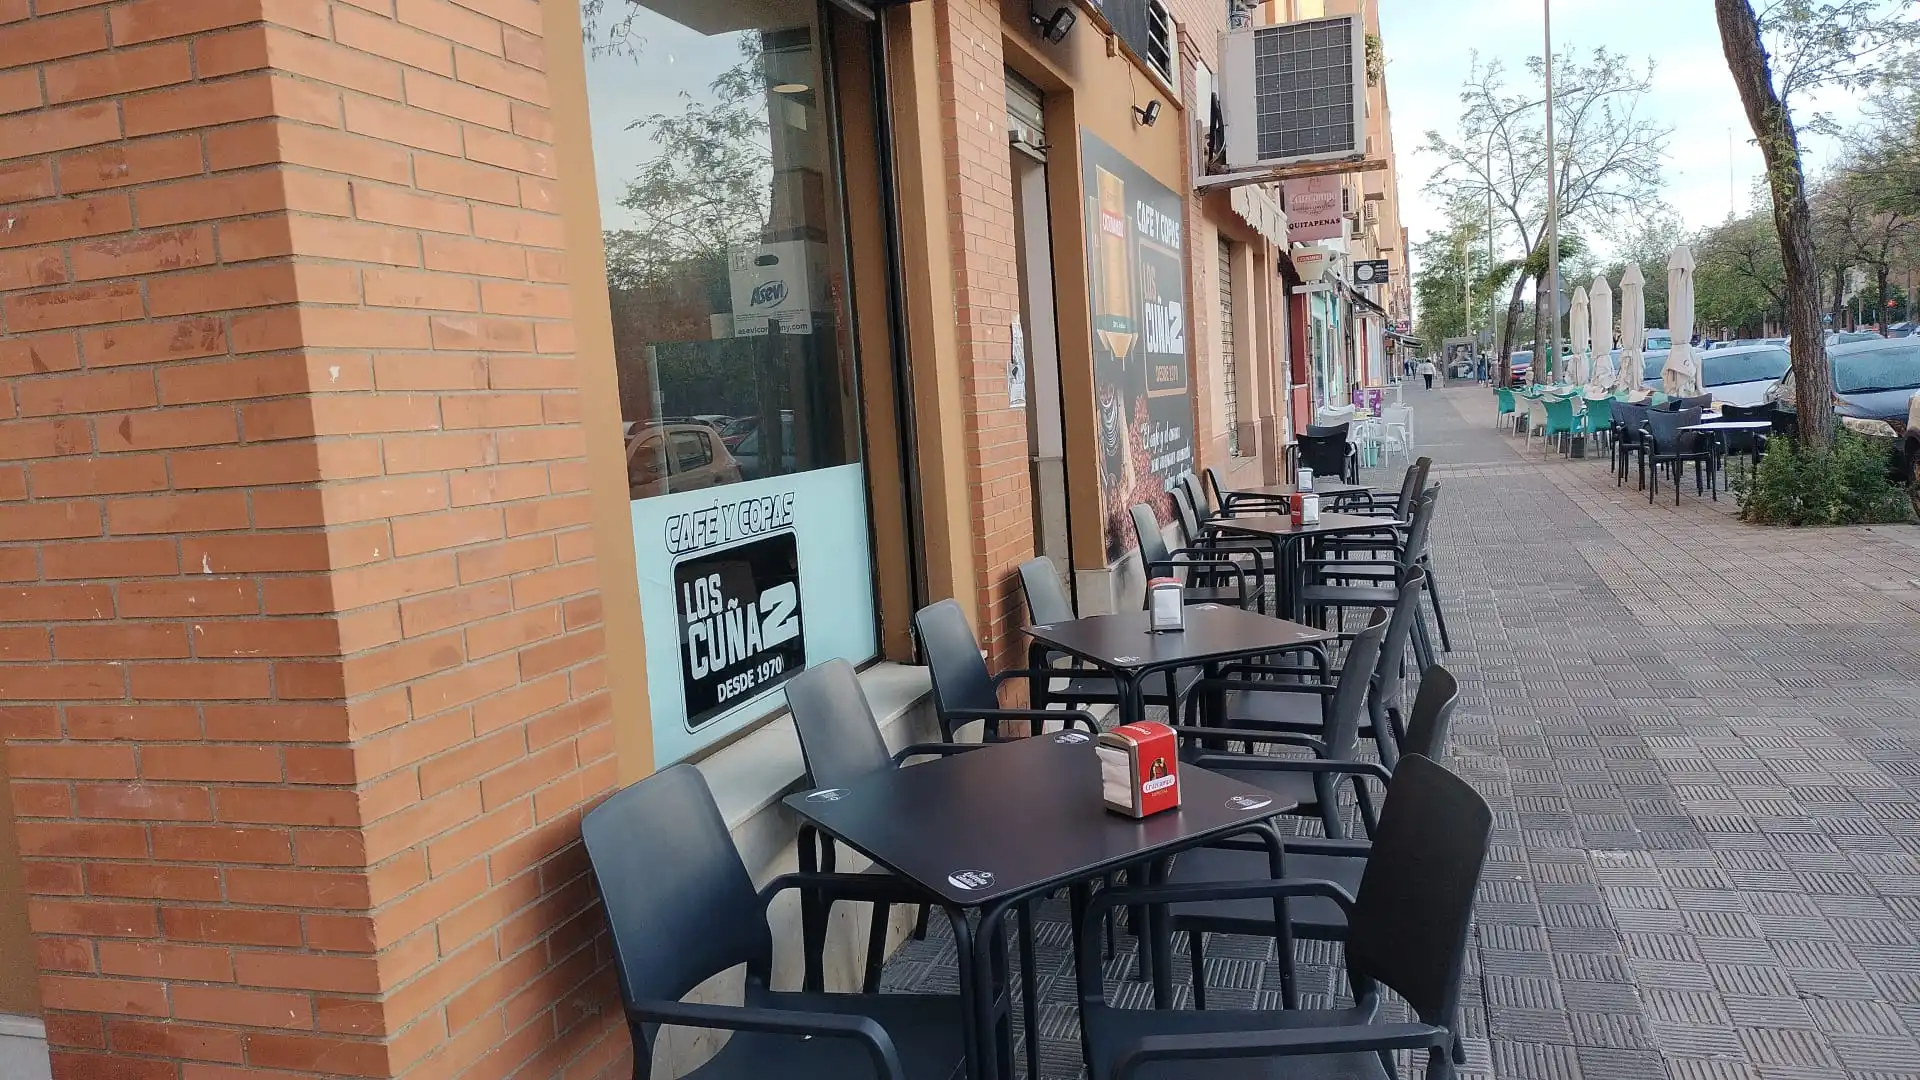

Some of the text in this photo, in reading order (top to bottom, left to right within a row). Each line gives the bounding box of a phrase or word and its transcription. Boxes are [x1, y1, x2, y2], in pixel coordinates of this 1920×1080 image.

[1155, 208, 1161, 241] Y
[1160, 213, 1180, 250] COPAS
[1288, 217, 1341, 230] QUITAPENAS
[750, 280, 784, 307] Asevi
[1143, 262, 1157, 302] LOS
[737, 323, 809, 335] asevicony.com
[665, 492, 795, 554] CAFÉ Y COPAS
[683, 573, 724, 624] LOS
[716, 659, 784, 703] DESDE 1970
